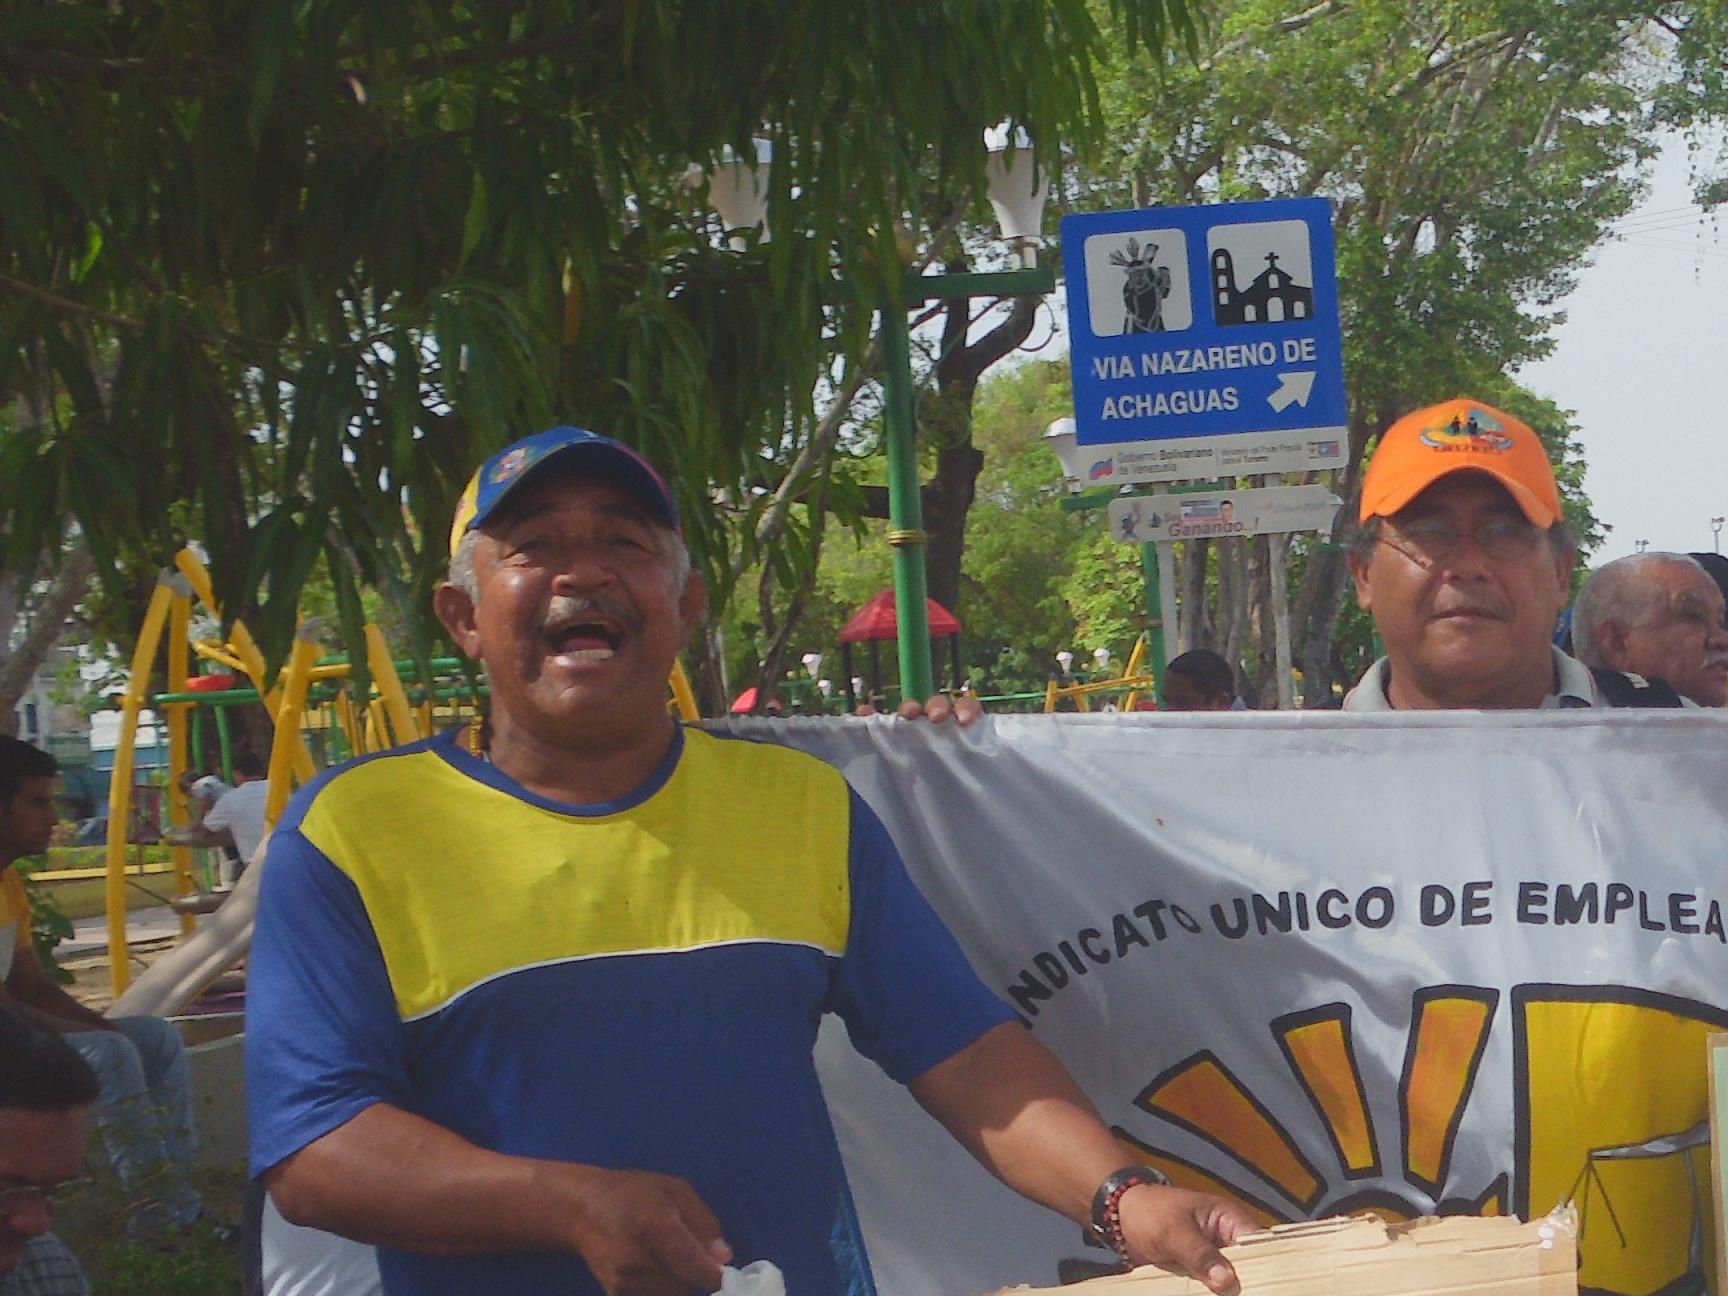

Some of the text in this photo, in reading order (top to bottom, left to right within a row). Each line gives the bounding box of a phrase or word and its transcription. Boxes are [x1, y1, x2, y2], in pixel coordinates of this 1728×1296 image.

[1095, 337, 1317, 380] VIA NAZARENO DE
[1101, 386, 1239, 421] ACHAGUAS
[1211, 884, 1395, 940] UNICO
[1420, 881, 1494, 928] DE
